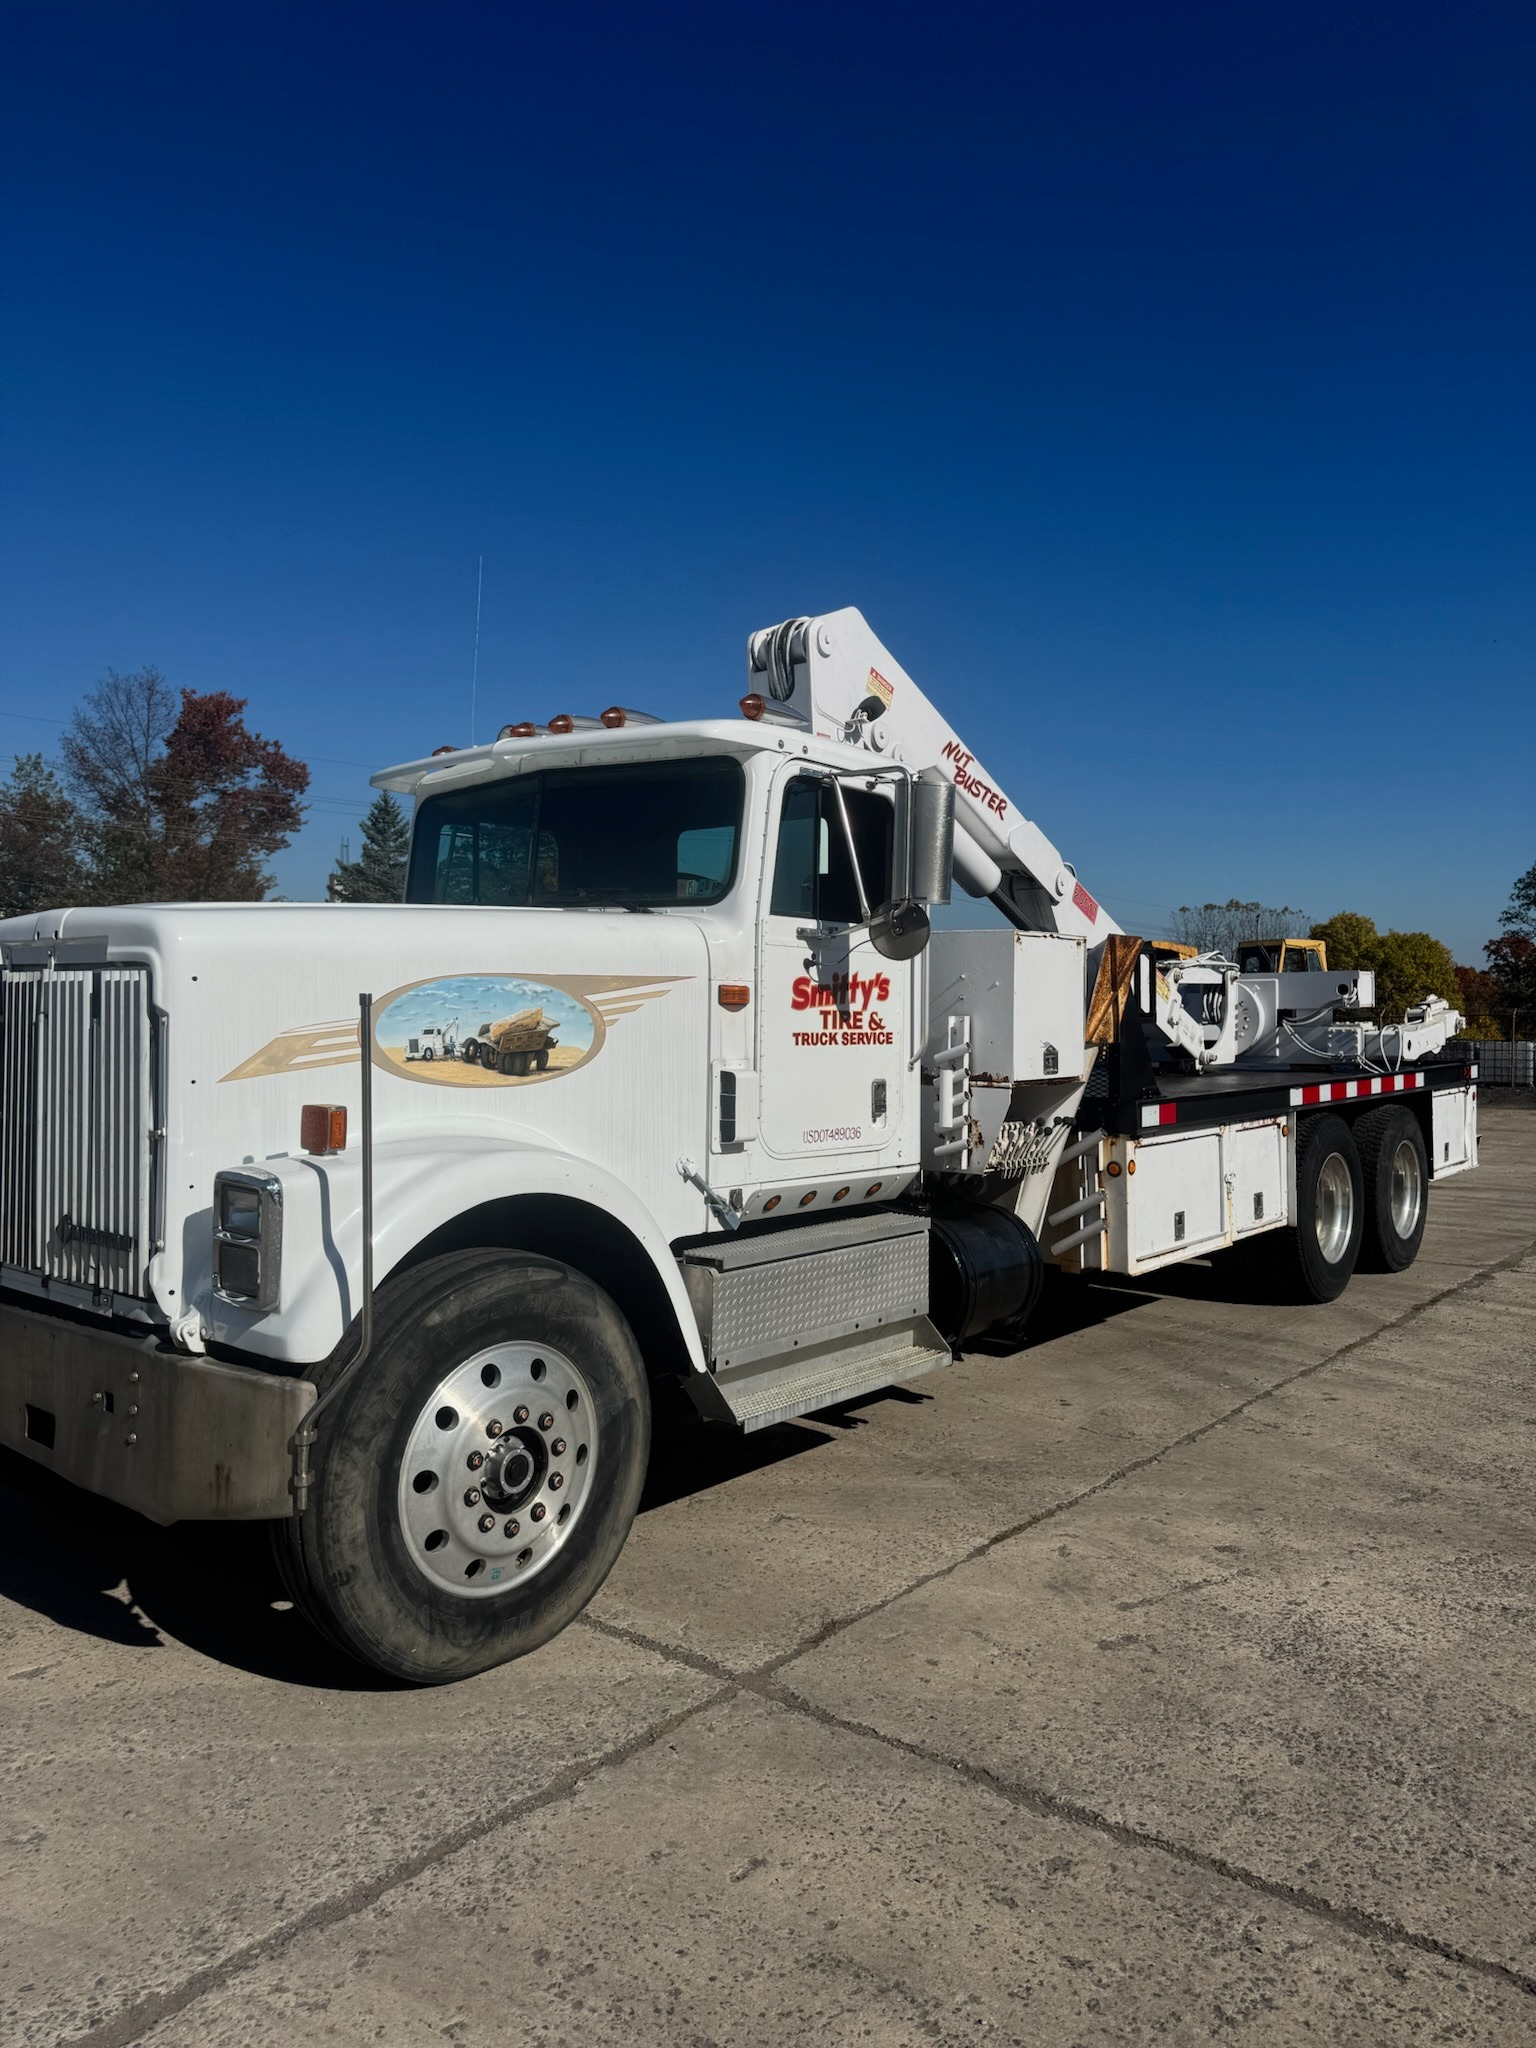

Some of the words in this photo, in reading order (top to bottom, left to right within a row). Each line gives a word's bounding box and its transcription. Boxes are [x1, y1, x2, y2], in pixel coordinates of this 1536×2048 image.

[941, 740, 975, 769] NUT
[953, 764, 1008, 821] BUSTER
[790, 971, 891, 1012] Smitty's
[819, 1010, 864, 1030] TIRE
[868, 1011, 886, 1031] &
[792, 1032, 839, 1046] TRUCK
[841, 1032, 893, 1046] SERVICE
[803, 1126, 862, 1144] USDOT489036
